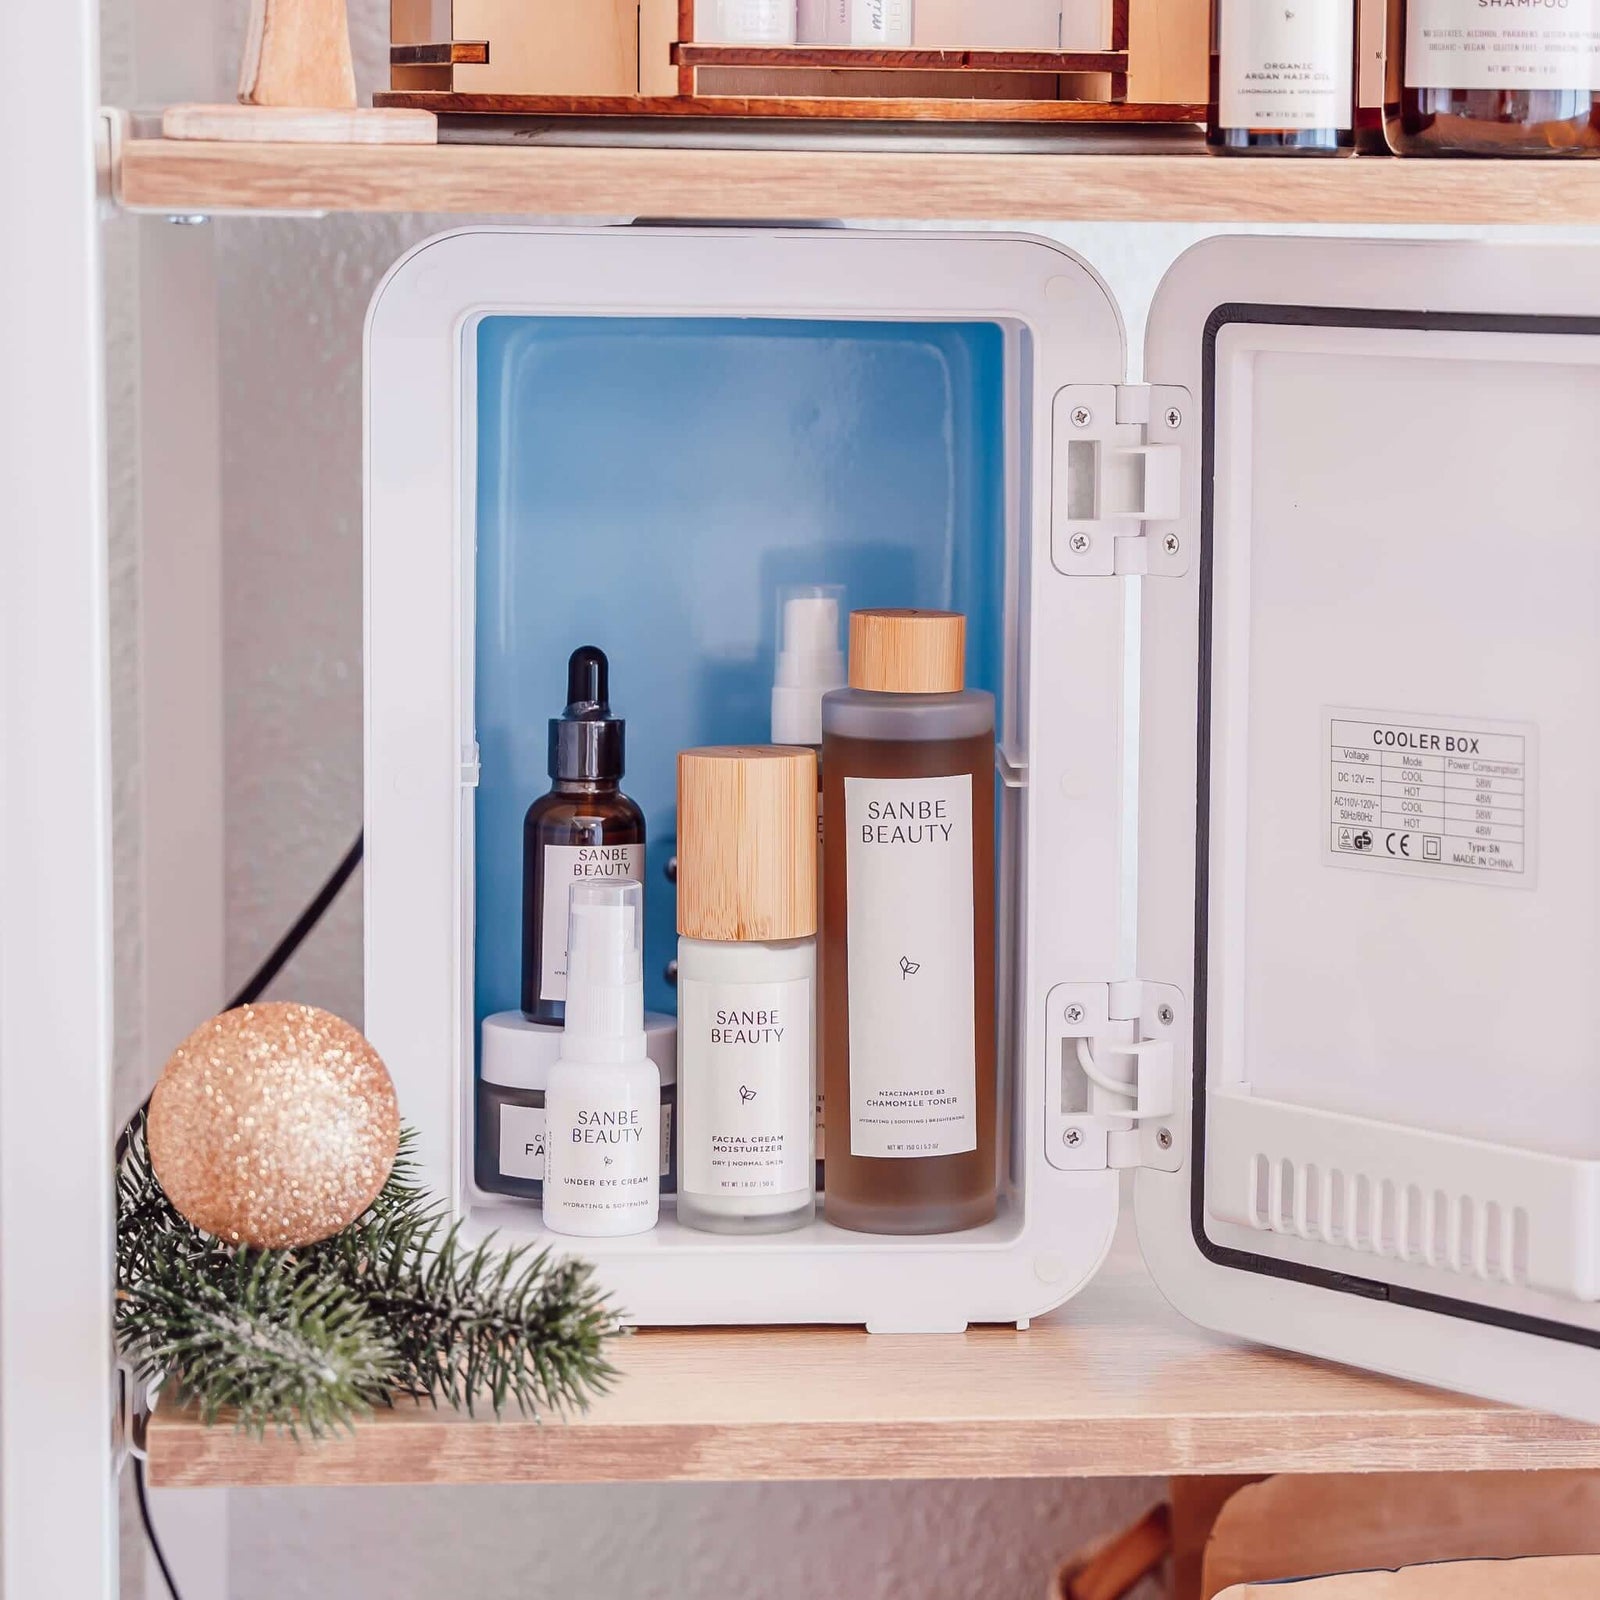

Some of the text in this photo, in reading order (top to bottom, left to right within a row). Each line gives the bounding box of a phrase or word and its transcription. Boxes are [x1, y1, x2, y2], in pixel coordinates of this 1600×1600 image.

[1478, 0, 1569, 8] SHAMPOO
[1463, 43, 1486, 51] VEGAN
[1264, 62, 1313, 70] ORGANIC
[1373, 729, 1480, 754] COOLER BOX
[1343, 749, 1370, 762] Voltage
[1402, 756, 1423, 767] Mode
[1447, 759, 1520, 776] Power Consumption
[1337, 772, 1349, 783] DC
[1401, 770, 1424, 783] COOL
[1475, 778, 1493, 789] 58W
[1403, 787, 1421, 797] HOT
[1475, 793, 1493, 805] 48W
[868, 799, 947, 820] SANBE
[1401, 801, 1424, 813] COOL
[1340, 810, 1373, 823] 50Hz/60Hz
[1475, 809, 1493, 820] 58W
[1403, 818, 1421, 829] HOT
[862, 823, 953, 844] BEAUTY
[1475, 826, 1493, 837] 48W
[578, 848, 629, 861] SANBE
[1452, 853, 1514, 869] MADE IN CHINA
[573, 863, 631, 877] BEAUTY
[716, 1009, 780, 1026] SANBE
[711, 1028, 785, 1044] BEAUTY
[879, 1089, 934, 1097] NIACINAMIDE
[866, 1097, 958, 1107] CHAMOMILE TONER
[577, 1109, 640, 1125] SANBE
[928, 1114, 966, 1123] BRIGHTENING
[572, 1127, 643, 1144] BEAUTY
[712, 1135, 784, 1144] FACIAL CREAM
[713, 1144, 783, 1153] MOISTURIZER
[765, 1159, 784, 1167] SKIN
[564, 1176, 649, 1187] UNDER EYE CREAM
[562, 1201, 604, 1210] HYDRATING
[612, 1199, 649, 1210] SOFTENING
